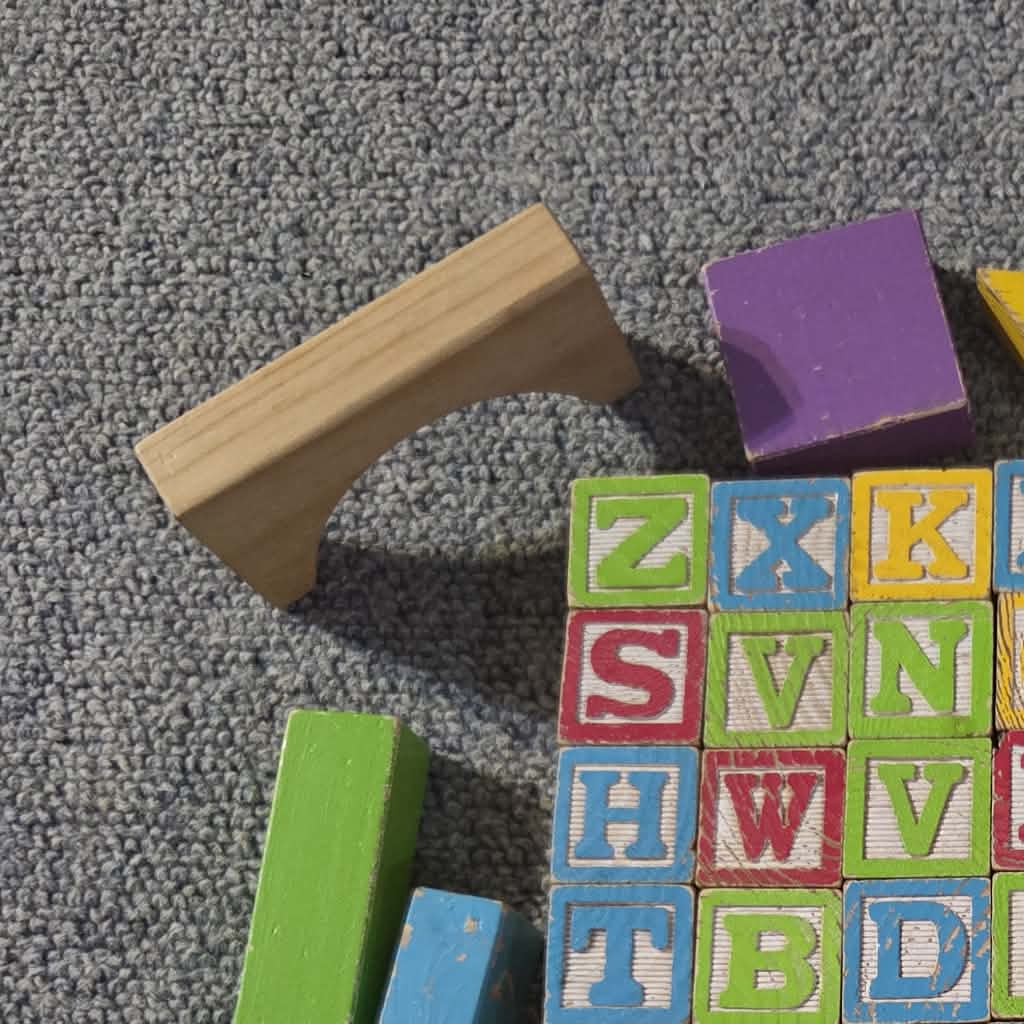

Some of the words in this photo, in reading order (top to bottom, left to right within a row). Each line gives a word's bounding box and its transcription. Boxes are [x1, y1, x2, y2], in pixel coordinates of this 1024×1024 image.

[596, 498, 688, 586] Z
[736, 497, 834, 593] X
[873, 489, 968, 579] K
[586, 628, 679, 718] S
[741, 636, 824, 728] V
[870, 620, 968, 712] N
[574, 771, 668, 859] H
[724, 772, 818, 861] W
[877, 762, 964, 857] V
[570, 906, 669, 1007] T
[719, 914, 817, 1008] B
[868, 901, 968, 999] D
